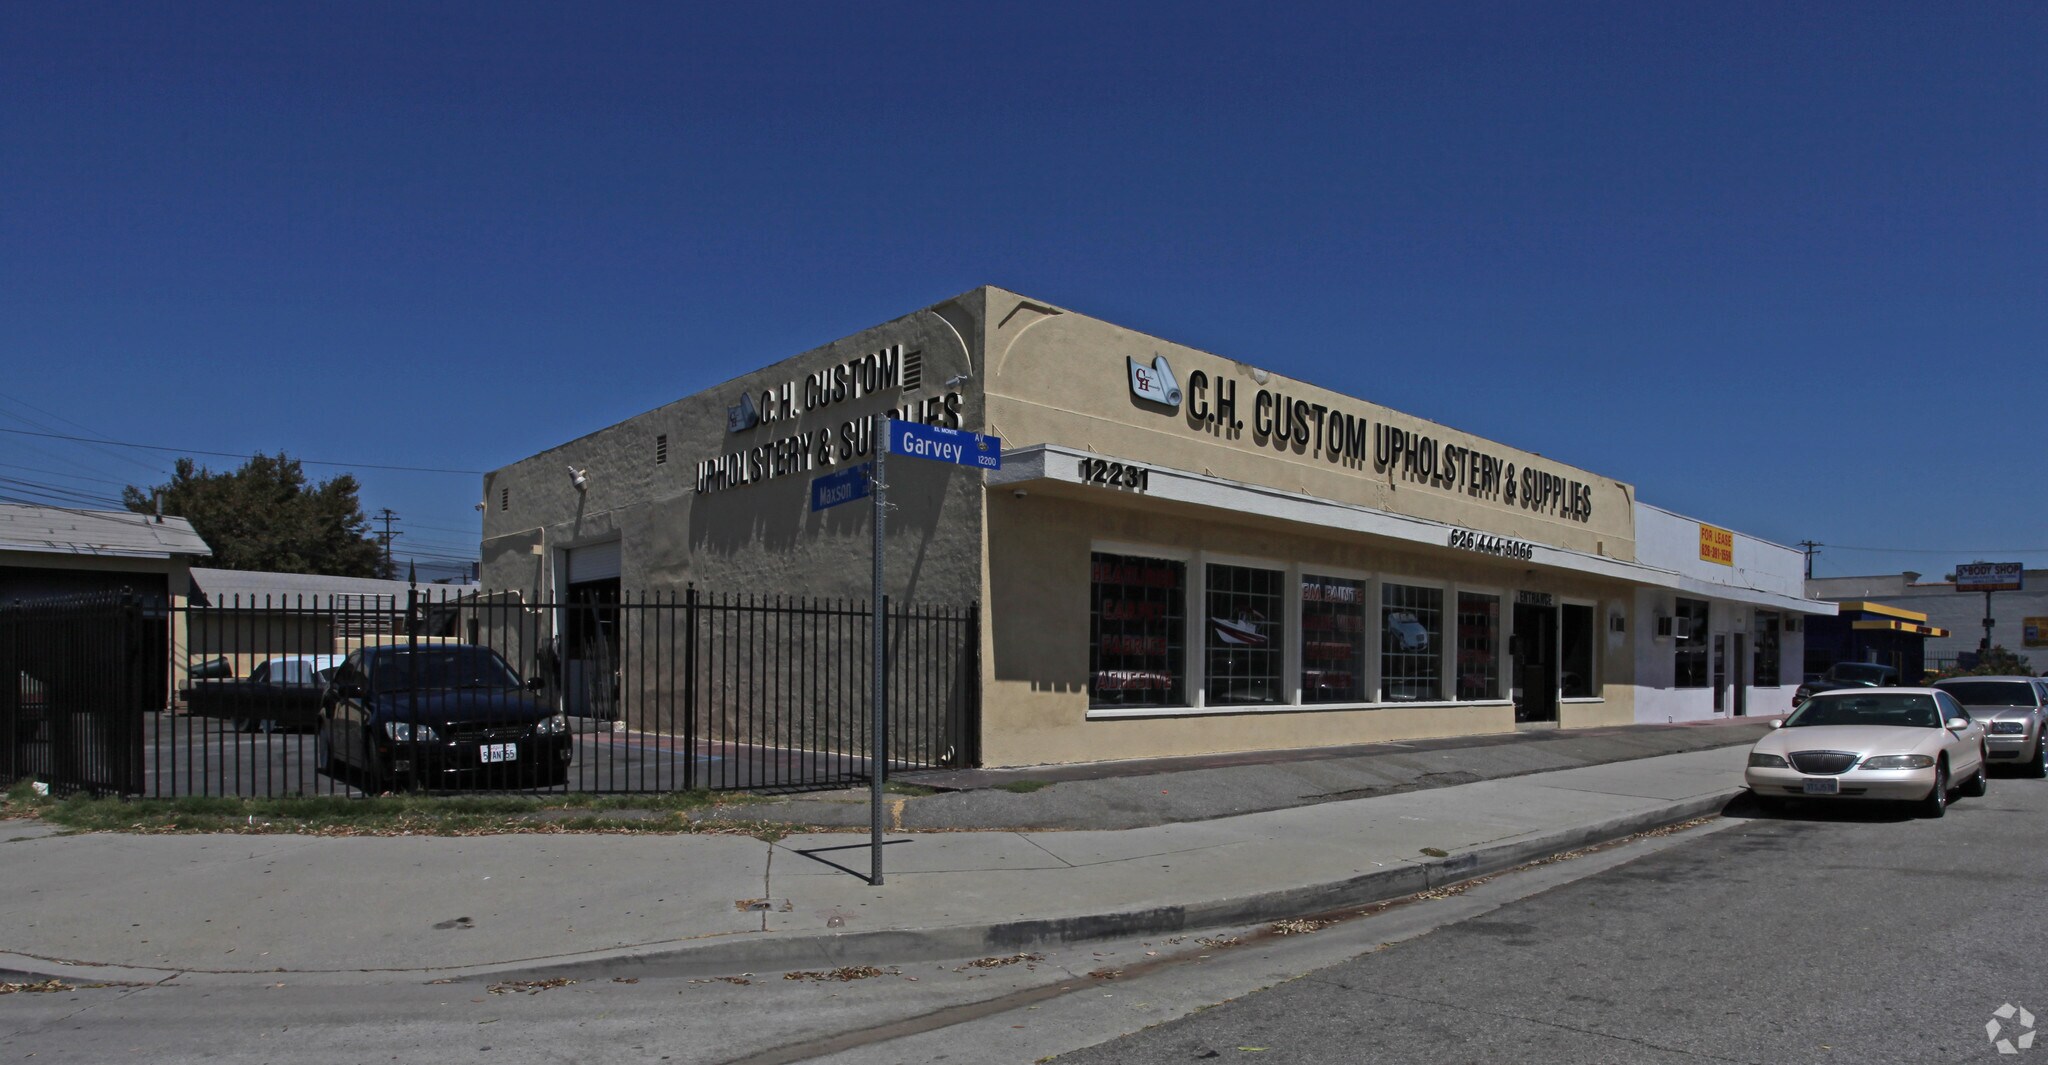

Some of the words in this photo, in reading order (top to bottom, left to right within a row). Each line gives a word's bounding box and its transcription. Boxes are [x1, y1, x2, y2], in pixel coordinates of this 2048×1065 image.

[761, 381, 800, 425] C.H.
[805, 344, 903, 412] CUSTOM
[941, 428, 958, 436] MONTE
[975, 433, 984, 443] AV
[903, 431, 963, 465] Garvey
[1189, 369, 1244, 430] C.H.
[1255, 390, 1367, 461] CUSTOM
[1375, 422, 1503, 495] UPHOLSTERY
[1505, 462, 1517, 499] &
[1521, 466, 1592, 517] SUPPLIES
[696, 431, 813, 495] UPHOLSTERY
[818, 427, 835, 466] &
[977, 455, 997, 468] 12200
[1082, 457, 1148, 490] 12231
[819, 483, 851, 506] Maxson
[1702, 528, 1712, 542] FOR
[1715, 532, 1731, 547] LEASE
[1968, 566, 1991, 575] BODY
[1995, 565, 2019, 575] SHOP
[1519, 590, 1552, 605] ENTRANCE
[1095, 670, 1172, 690] ADHESIVE
